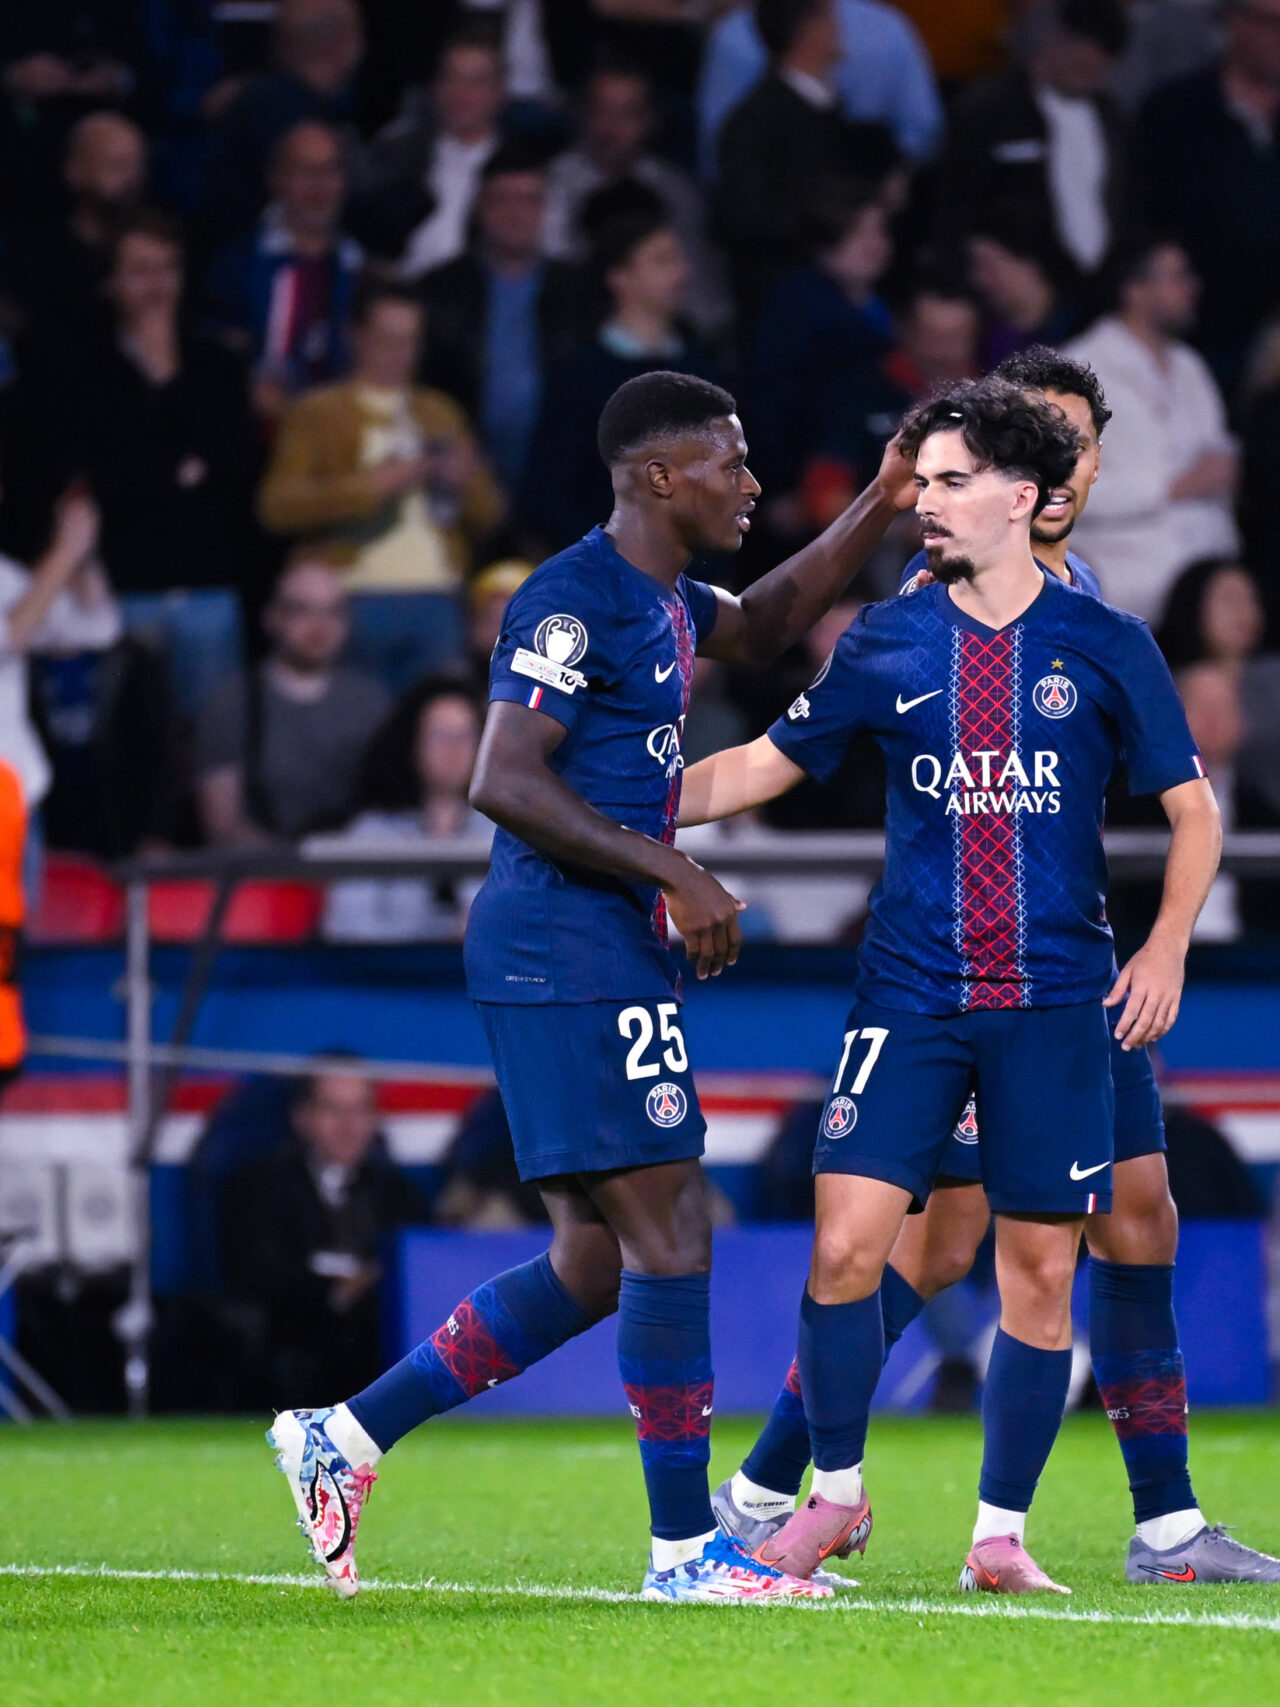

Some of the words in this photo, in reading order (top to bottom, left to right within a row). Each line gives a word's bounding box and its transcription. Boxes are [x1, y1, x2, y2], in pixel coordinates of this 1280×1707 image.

[1040, 677, 1070, 689] PARIS
[911, 750, 1062, 799] QATAR
[944, 790, 1061, 816] AIRWAYS
[617, 1003, 688, 1081] 25
[832, 1027, 890, 1095] 17
[650, 1084, 677, 1099] PARIS
